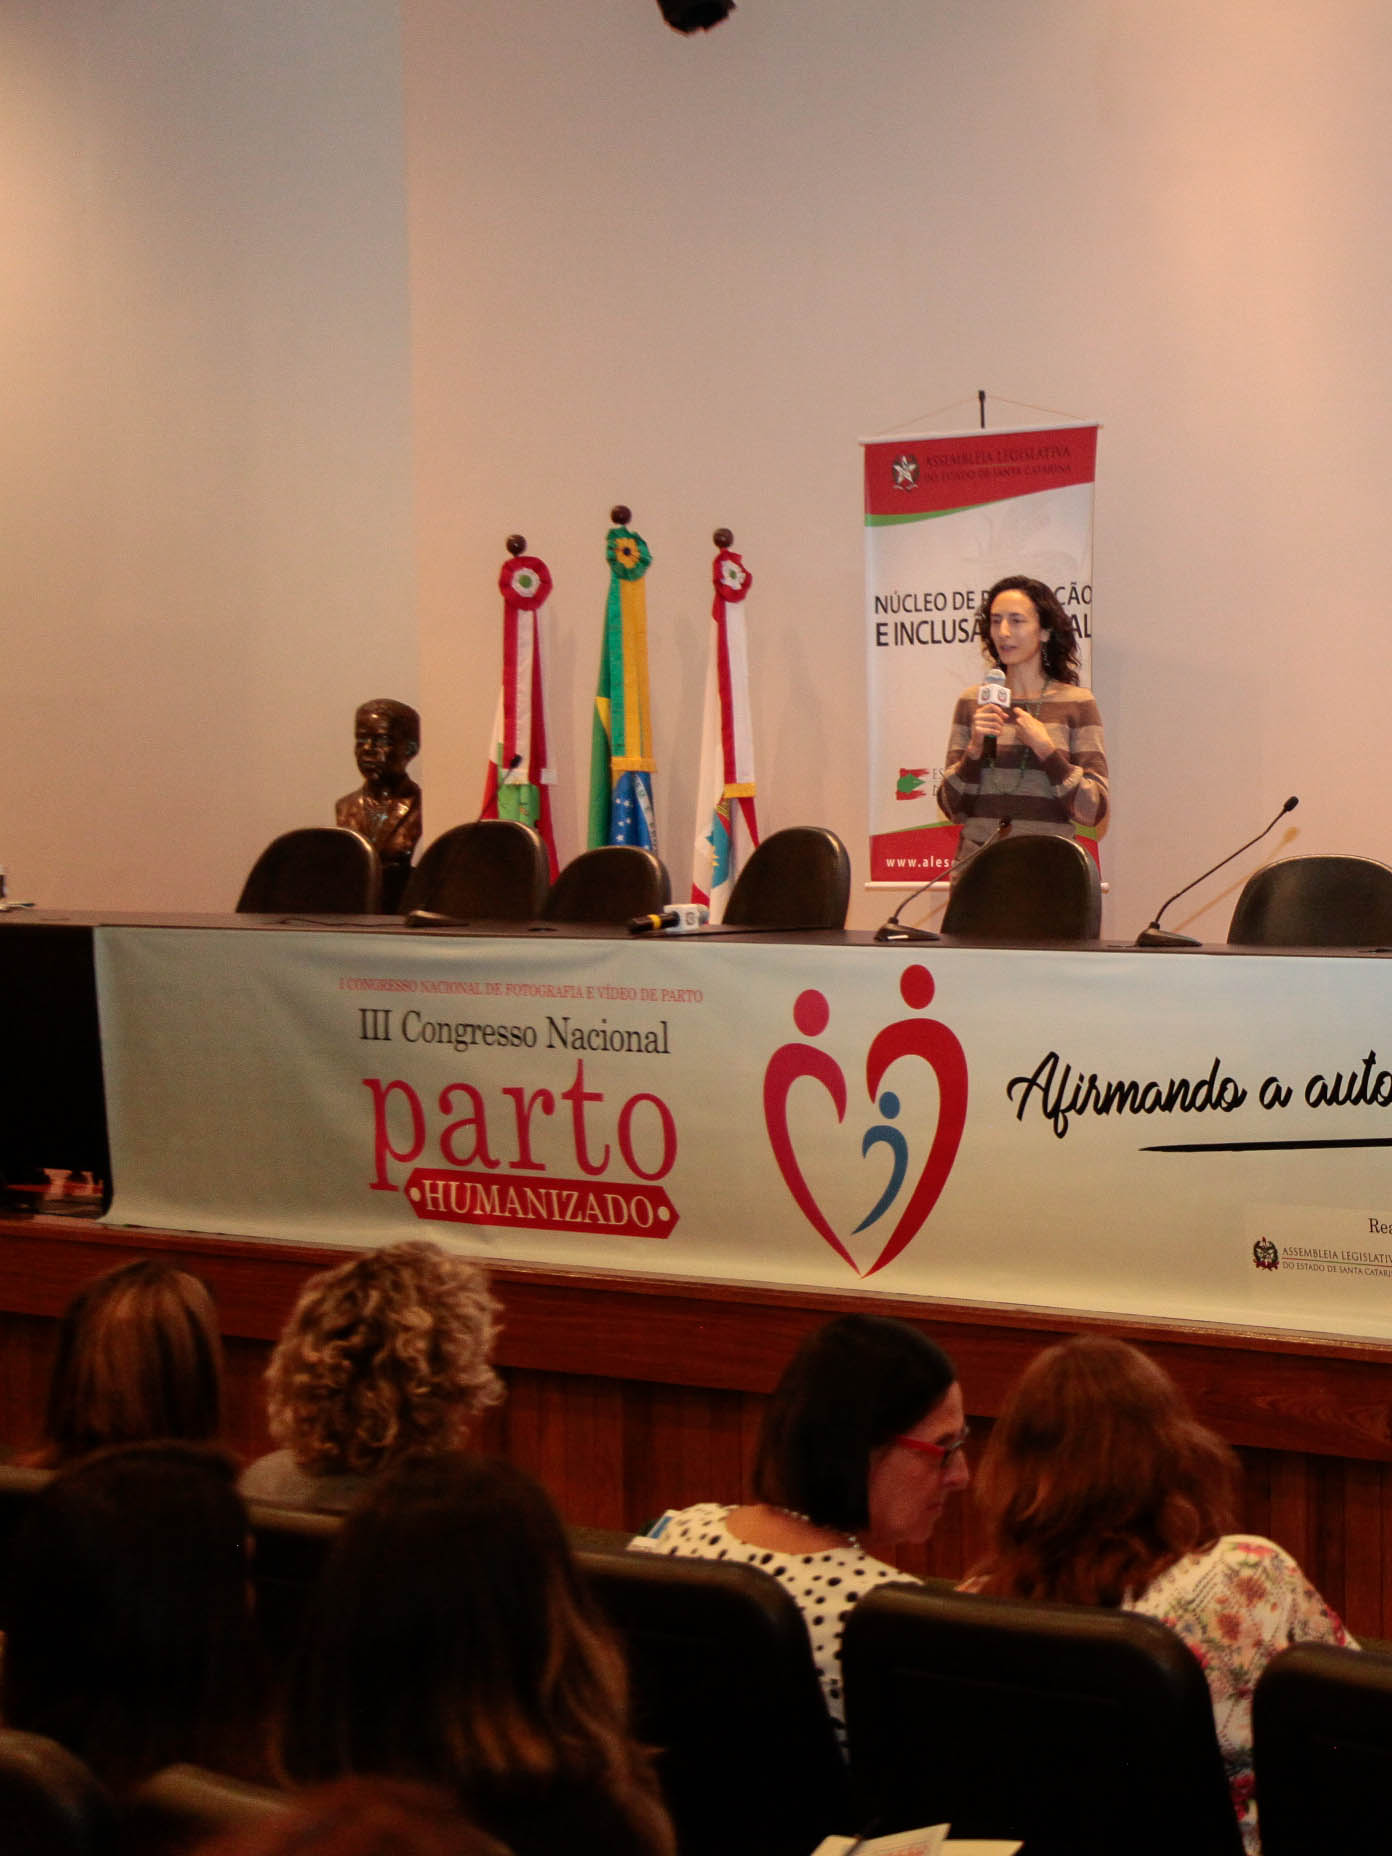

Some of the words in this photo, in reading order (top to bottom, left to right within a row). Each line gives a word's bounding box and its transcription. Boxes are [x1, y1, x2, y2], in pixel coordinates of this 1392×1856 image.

[875, 590, 947, 614] NÚCLEO
[952, 591, 975, 611] DE
[876, 622, 889, 646] E
[894, 615, 983, 646] INCLUSÃ
[346, 978, 418, 992] CONGRESSO
[421, 980, 481, 995] NACIONAL
[485, 982, 502, 995] DE
[505, 983, 584, 999] FOTOGRAFIA
[596, 984, 637, 1000] VÍDEO
[640, 988, 658, 1001] DE
[661, 988, 704, 1003] PARTO
[358, 1008, 392, 1041] III
[402, 1010, 537, 1052] Congresso
[546, 1016, 671, 1054] Nacional
[1007, 1051, 1247, 1138] Afirmando
[1259, 1074, 1293, 1110] a
[362, 1058, 678, 1192] parto
[422, 1180, 654, 1228] HUMANIZADO
[1282, 1247, 1339, 1259] ASSEMBLEIA
[1282, 1261, 1294, 1270] DO
[1297, 1262, 1325, 1272] ESTADO
[1327, 1265, 1337, 1273] DE
[1340, 1265, 1362, 1275] SANTA
